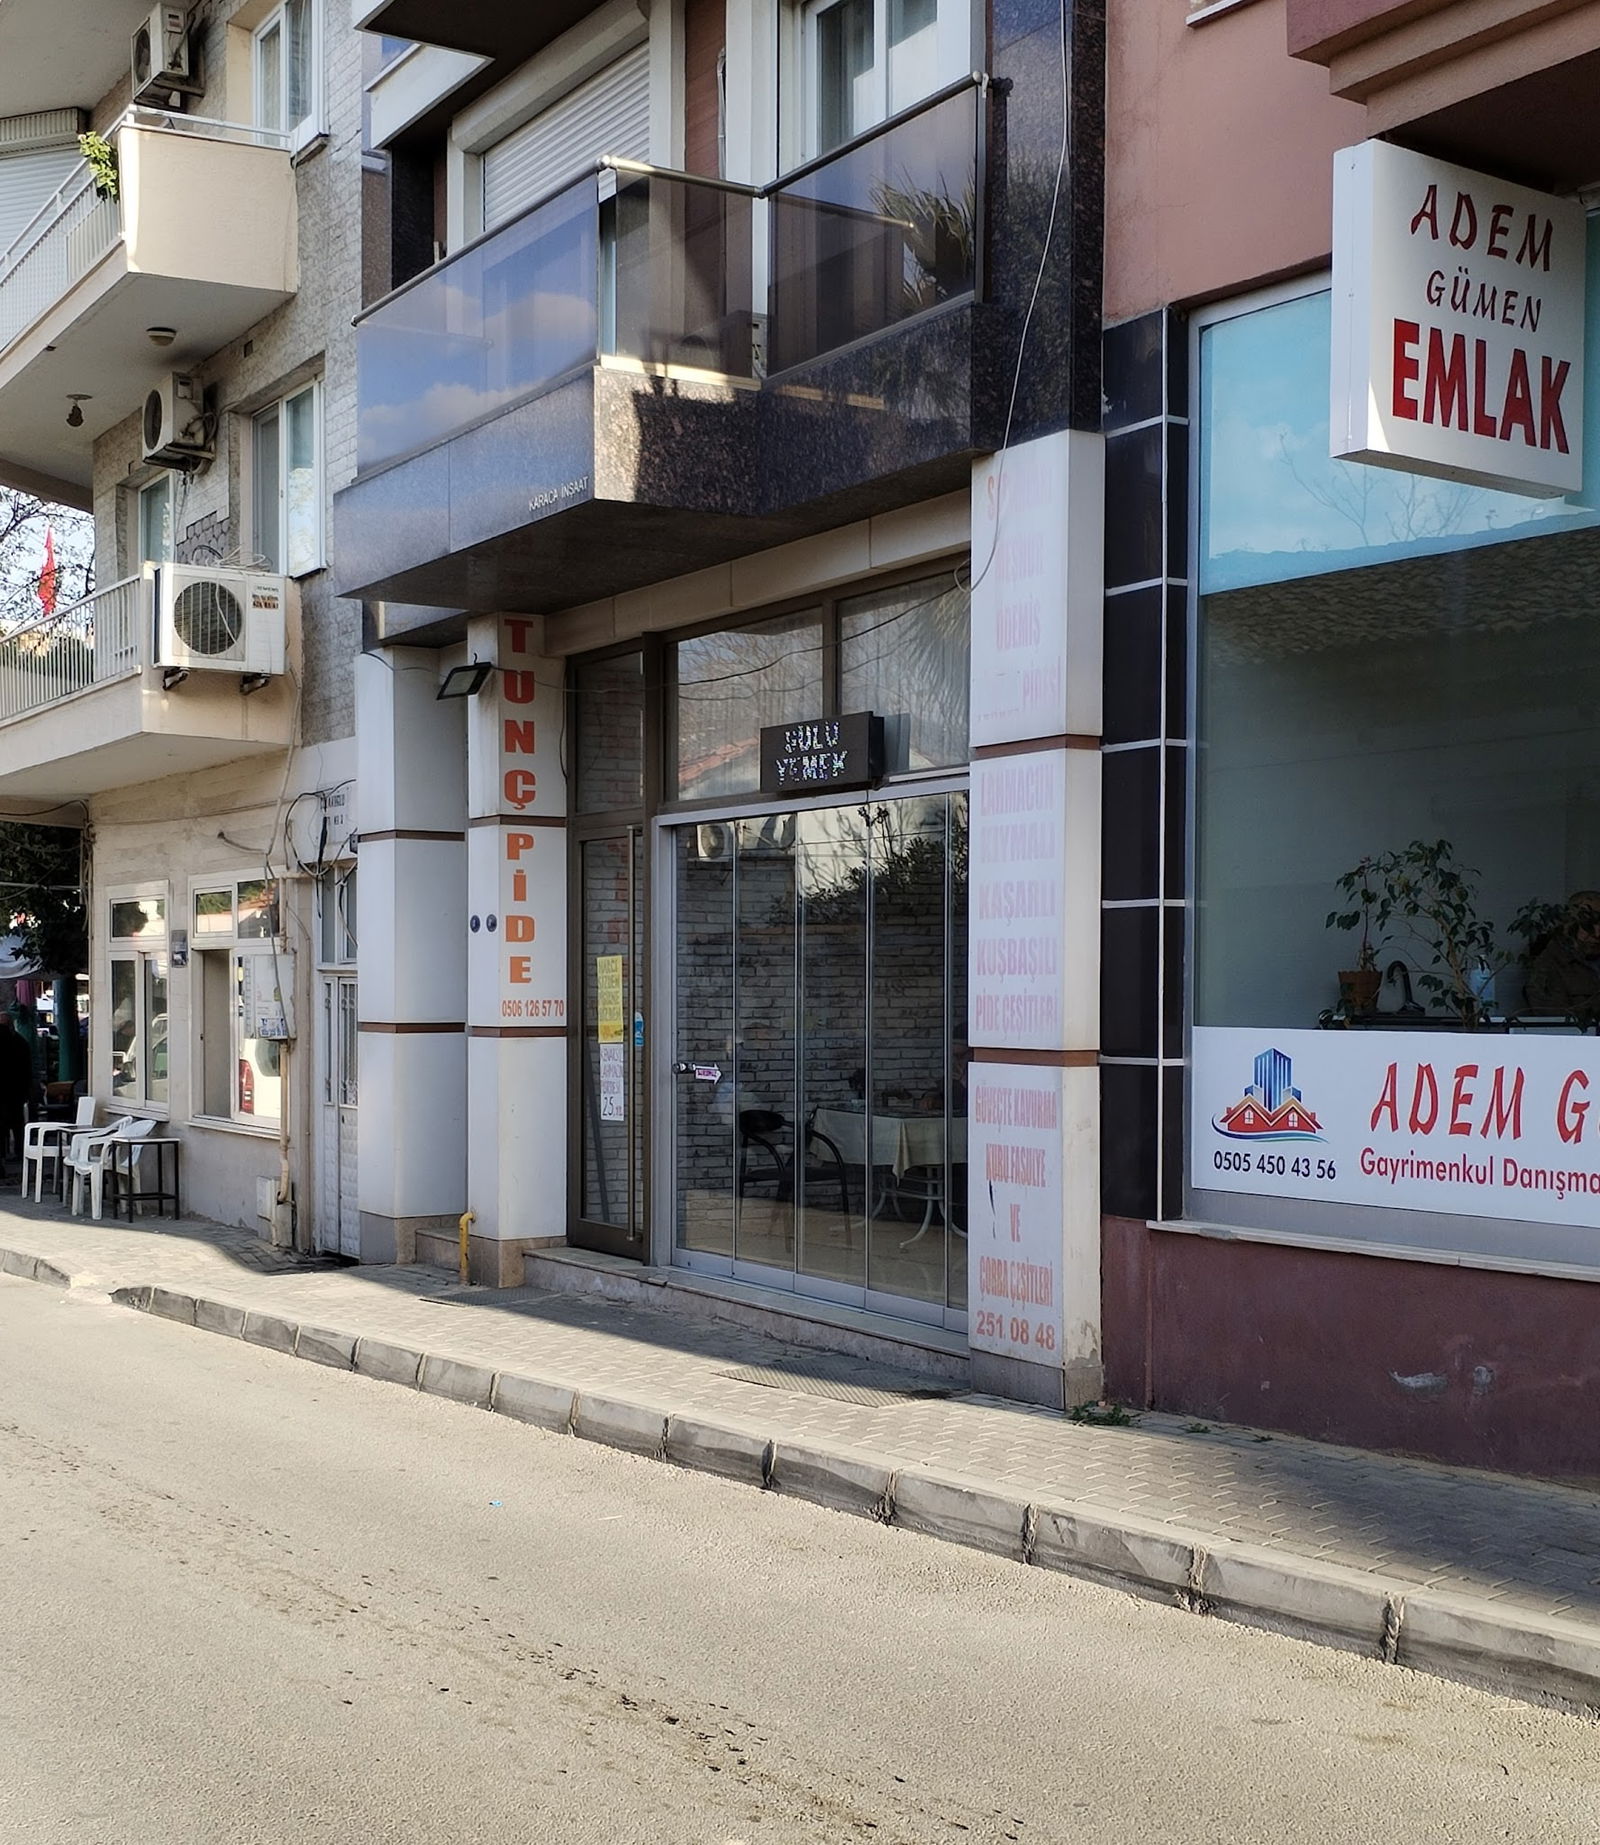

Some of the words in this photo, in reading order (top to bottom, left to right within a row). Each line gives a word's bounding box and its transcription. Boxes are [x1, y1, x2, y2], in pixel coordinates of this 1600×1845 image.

[1411, 184, 1553, 271] ADEM
[1427, 266, 1541, 332] GÜMEN
[1392, 318, 1571, 454] EMLAK
[529, 487, 559, 512] KARACA
[504, 619, 536, 810] TUNÇ
[775, 751, 848, 785] YEMEK
[506, 833, 534, 983] PİDE
[979, 880, 1056, 926] KAŞARLI
[977, 937, 1057, 983] KUŞBAŞILI
[502, 999, 522, 1016] 0506
[525, 999, 540, 1016] 126
[542, 999, 552, 1016] 57
[554, 999, 564, 1016] 70
[976, 987, 999, 1031] PİDE
[1014, 1088, 1057, 1129] KAVURMA
[1371, 1062, 1525, 1139] ADEM
[1010, 1146, 1046, 1188] FASULYE
[1214, 1150, 1251, 1172] 0505
[1256, 1154, 1286, 1175] 450
[1291, 1157, 1311, 1178] 43
[1316, 1159, 1336, 1180] 56
[1361, 1147, 1494, 1185] Gayrimenkul
[1010, 1203, 1021, 1243] VE
[1010, 1317, 1029, 1345] 08
[1035, 1322, 1055, 1350] 48
